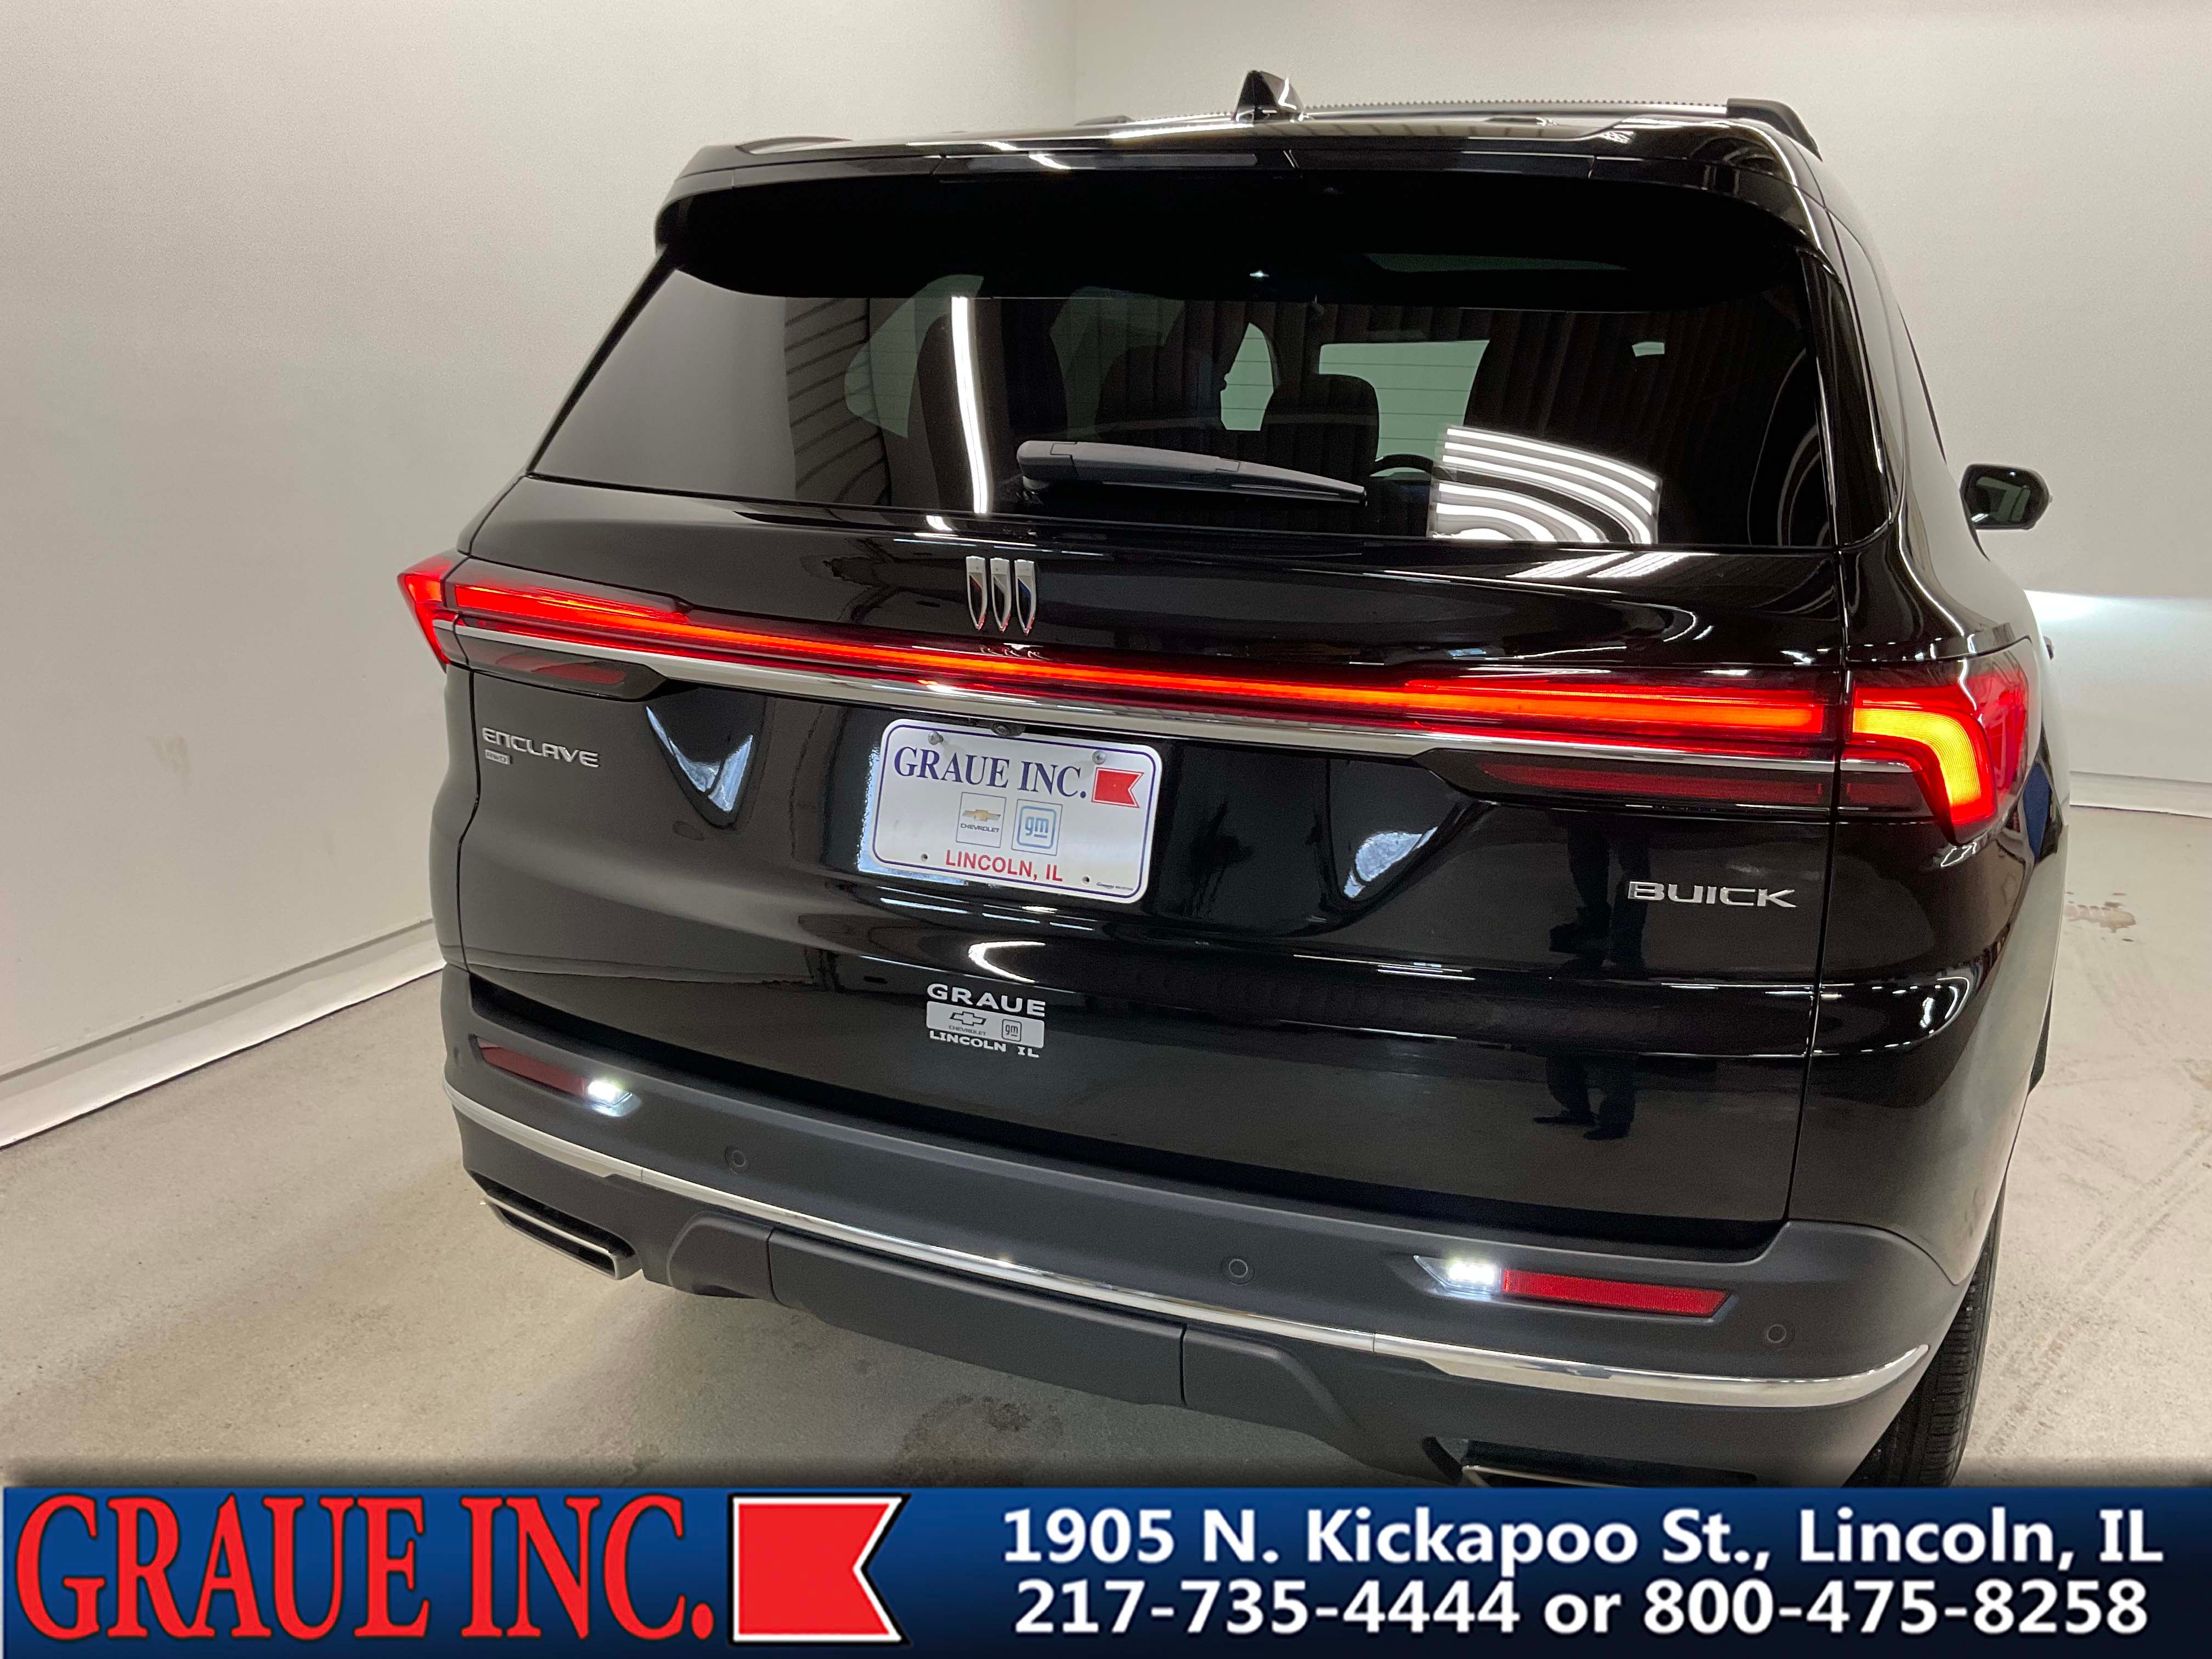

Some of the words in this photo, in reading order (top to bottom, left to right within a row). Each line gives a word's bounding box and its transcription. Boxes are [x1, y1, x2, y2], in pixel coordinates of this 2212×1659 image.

[482, 727, 599, 768] ENCLAVE
[486, 752, 507, 763] AWD
[894, 747, 1010, 788] GRAUE
[1017, 760, 1086, 799] INC.
[960, 823, 1000, 833] CHEVROLET
[1025, 816, 1049, 838] gm
[946, 850, 1037, 881] LINCOLN,
[1046, 864, 1063, 882] IL
[1628, 881, 1797, 908] BUICK
[927, 983, 1046, 1017] GRAUE
[929, 1030, 1007, 1052] LINCOLN
[1018, 1046, 1040, 1058] IL
[948, 1025, 987, 1036] CHEVROLET
